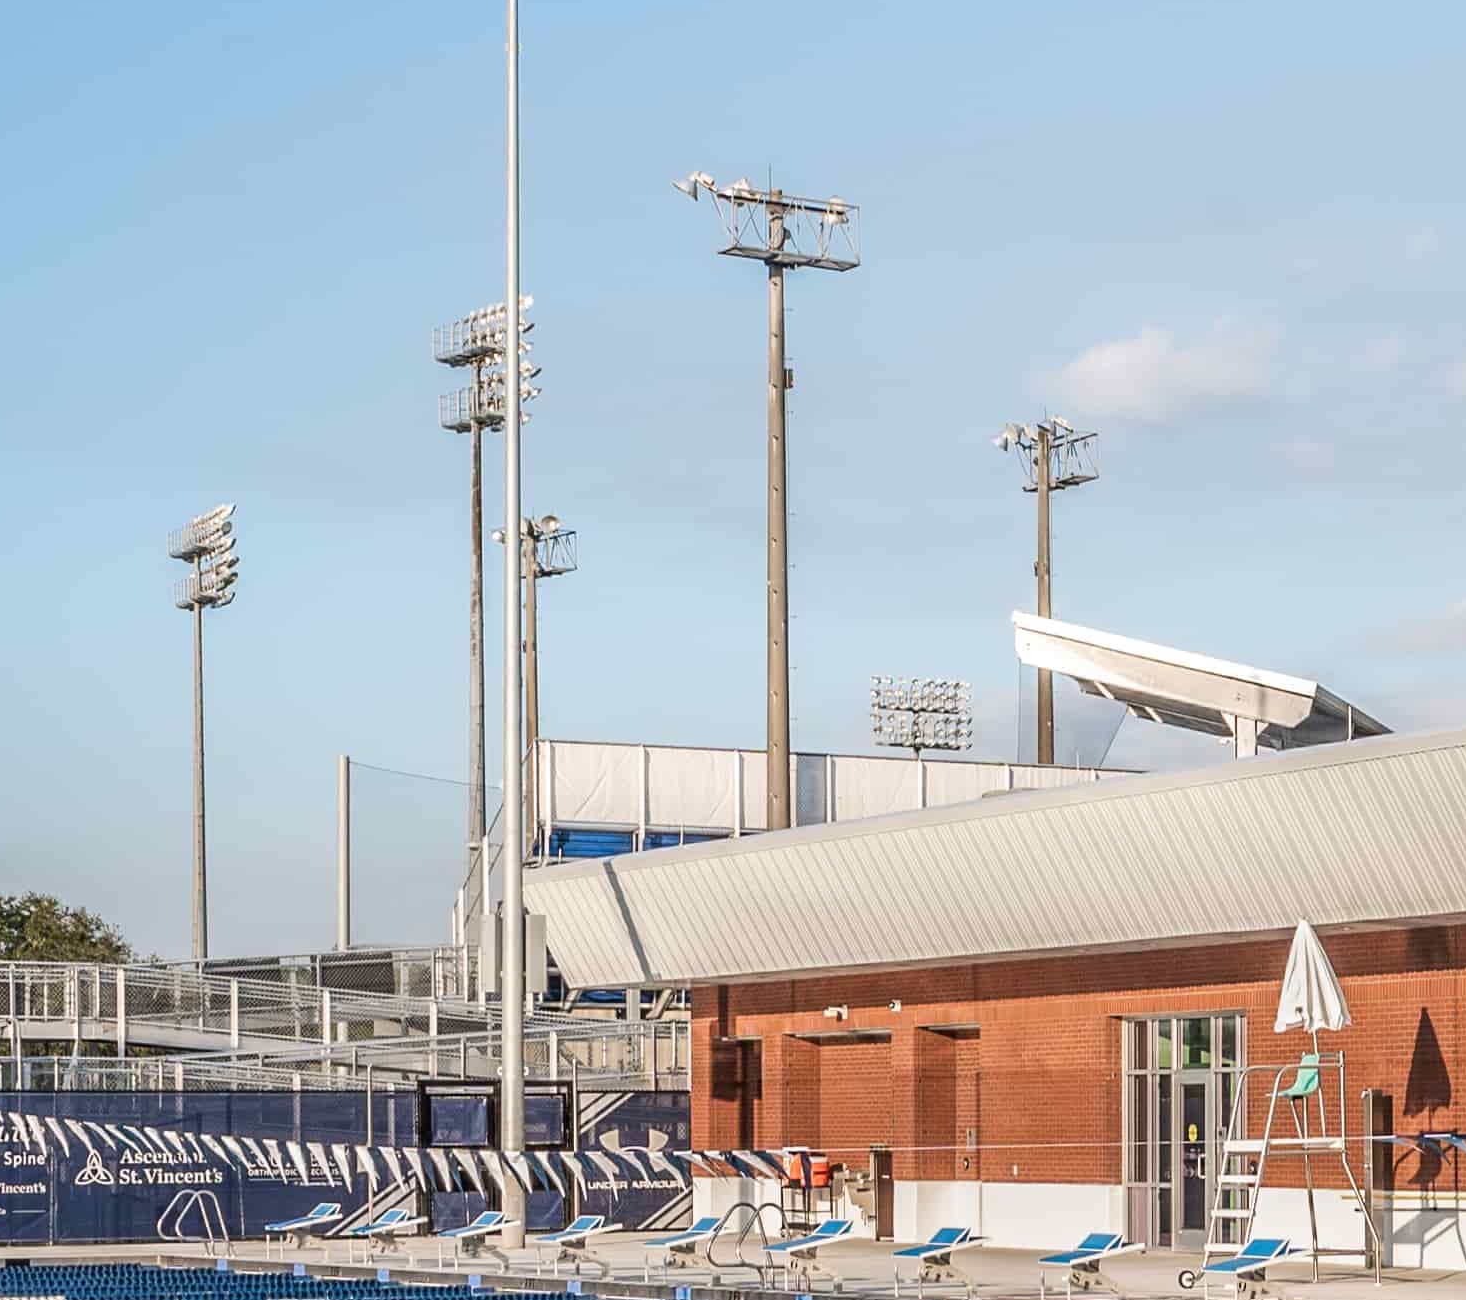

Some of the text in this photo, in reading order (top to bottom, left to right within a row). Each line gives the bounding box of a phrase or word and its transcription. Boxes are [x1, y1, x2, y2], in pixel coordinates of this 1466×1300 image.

[3, 1151, 46, 1168] Spine
[119, 1148, 208, 1165] Ascenin
[118, 1167, 224, 1185] St. Vincent's
[587, 1180, 628, 1190] UNDER
